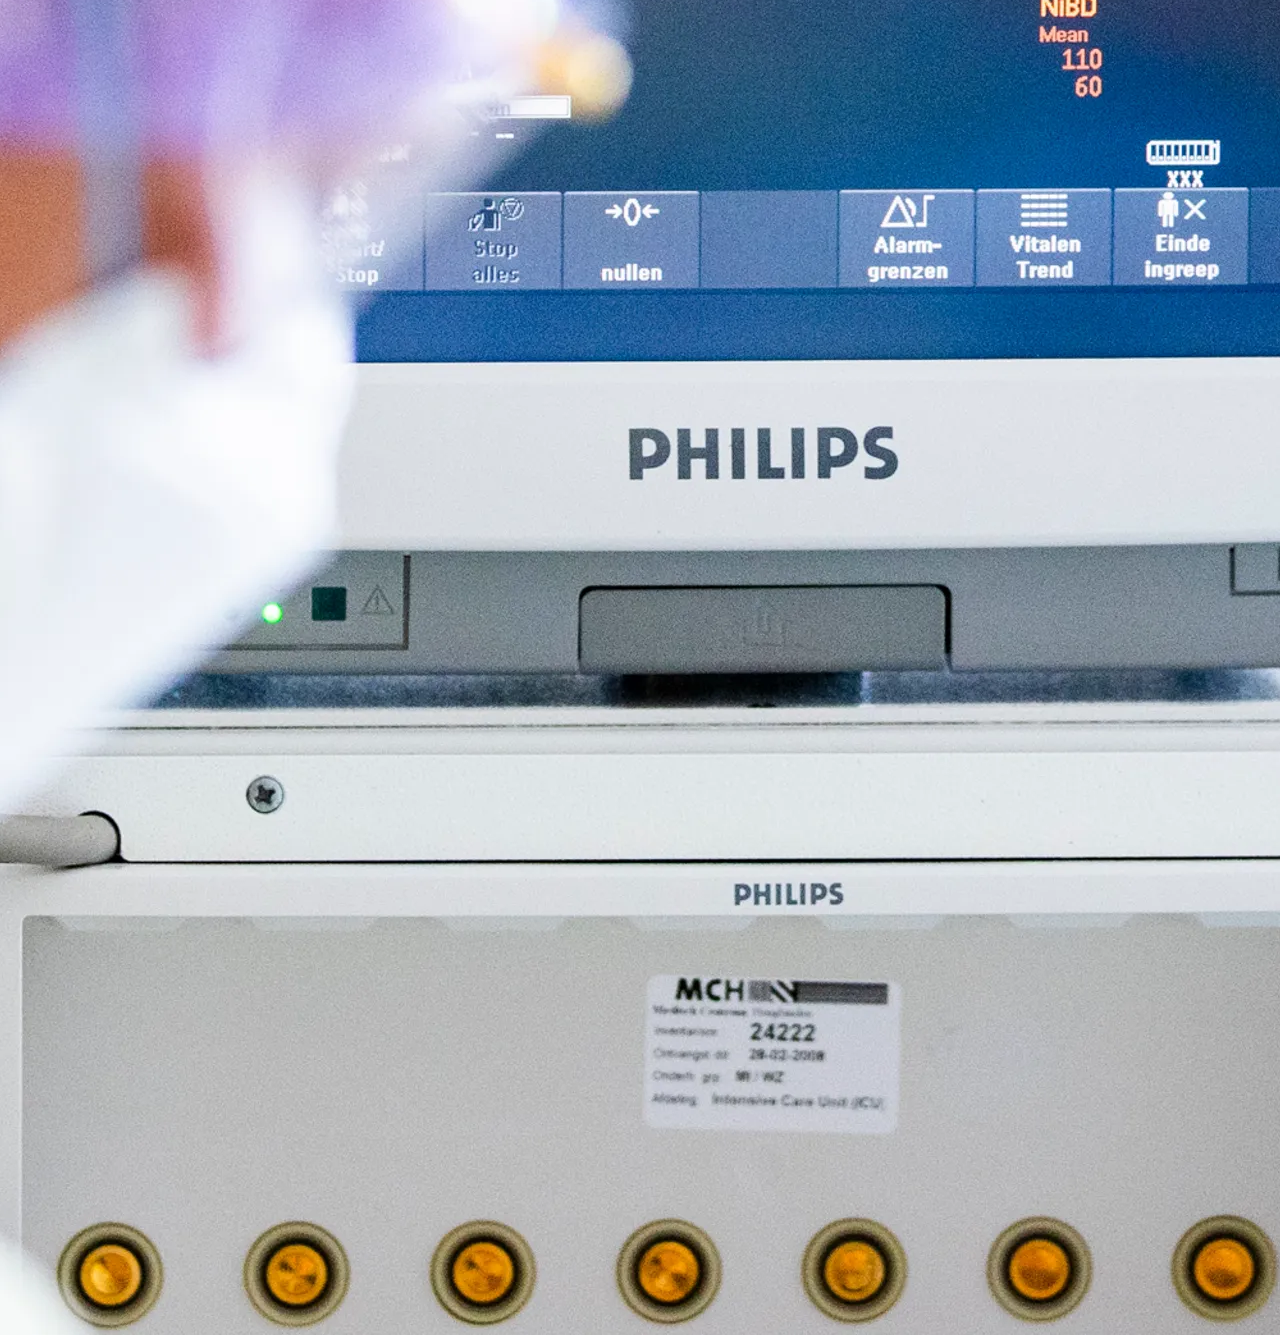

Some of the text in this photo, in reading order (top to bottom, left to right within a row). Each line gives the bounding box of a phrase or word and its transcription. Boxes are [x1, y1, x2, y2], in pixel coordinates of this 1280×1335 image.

[1039, 25, 1089, 43] Mean
[1061, 49, 1103, 71] 110
[1075, 75, 1103, 98] 60
[474, 239, 519, 261] Stop
[873, 234, 942, 255] Alarm-
[1010, 234, 1082, 255] Vitalen
[1155, 233, 1211, 254] Einde
[337, 266, 380, 287] Stop
[472, 265, 521, 284] alles
[601, 263, 663, 283] nullen
[867, 263, 949, 285] grenzen
[1016, 260, 1074, 280] Trend
[1144, 259, 1220, 283] ingreep
[628, 425, 900, 481] PHILIPS
[733, 882, 845, 906] PHILIPS
[675, 977, 745, 1003] MCH
[749, 1022, 816, 1042] 24222
